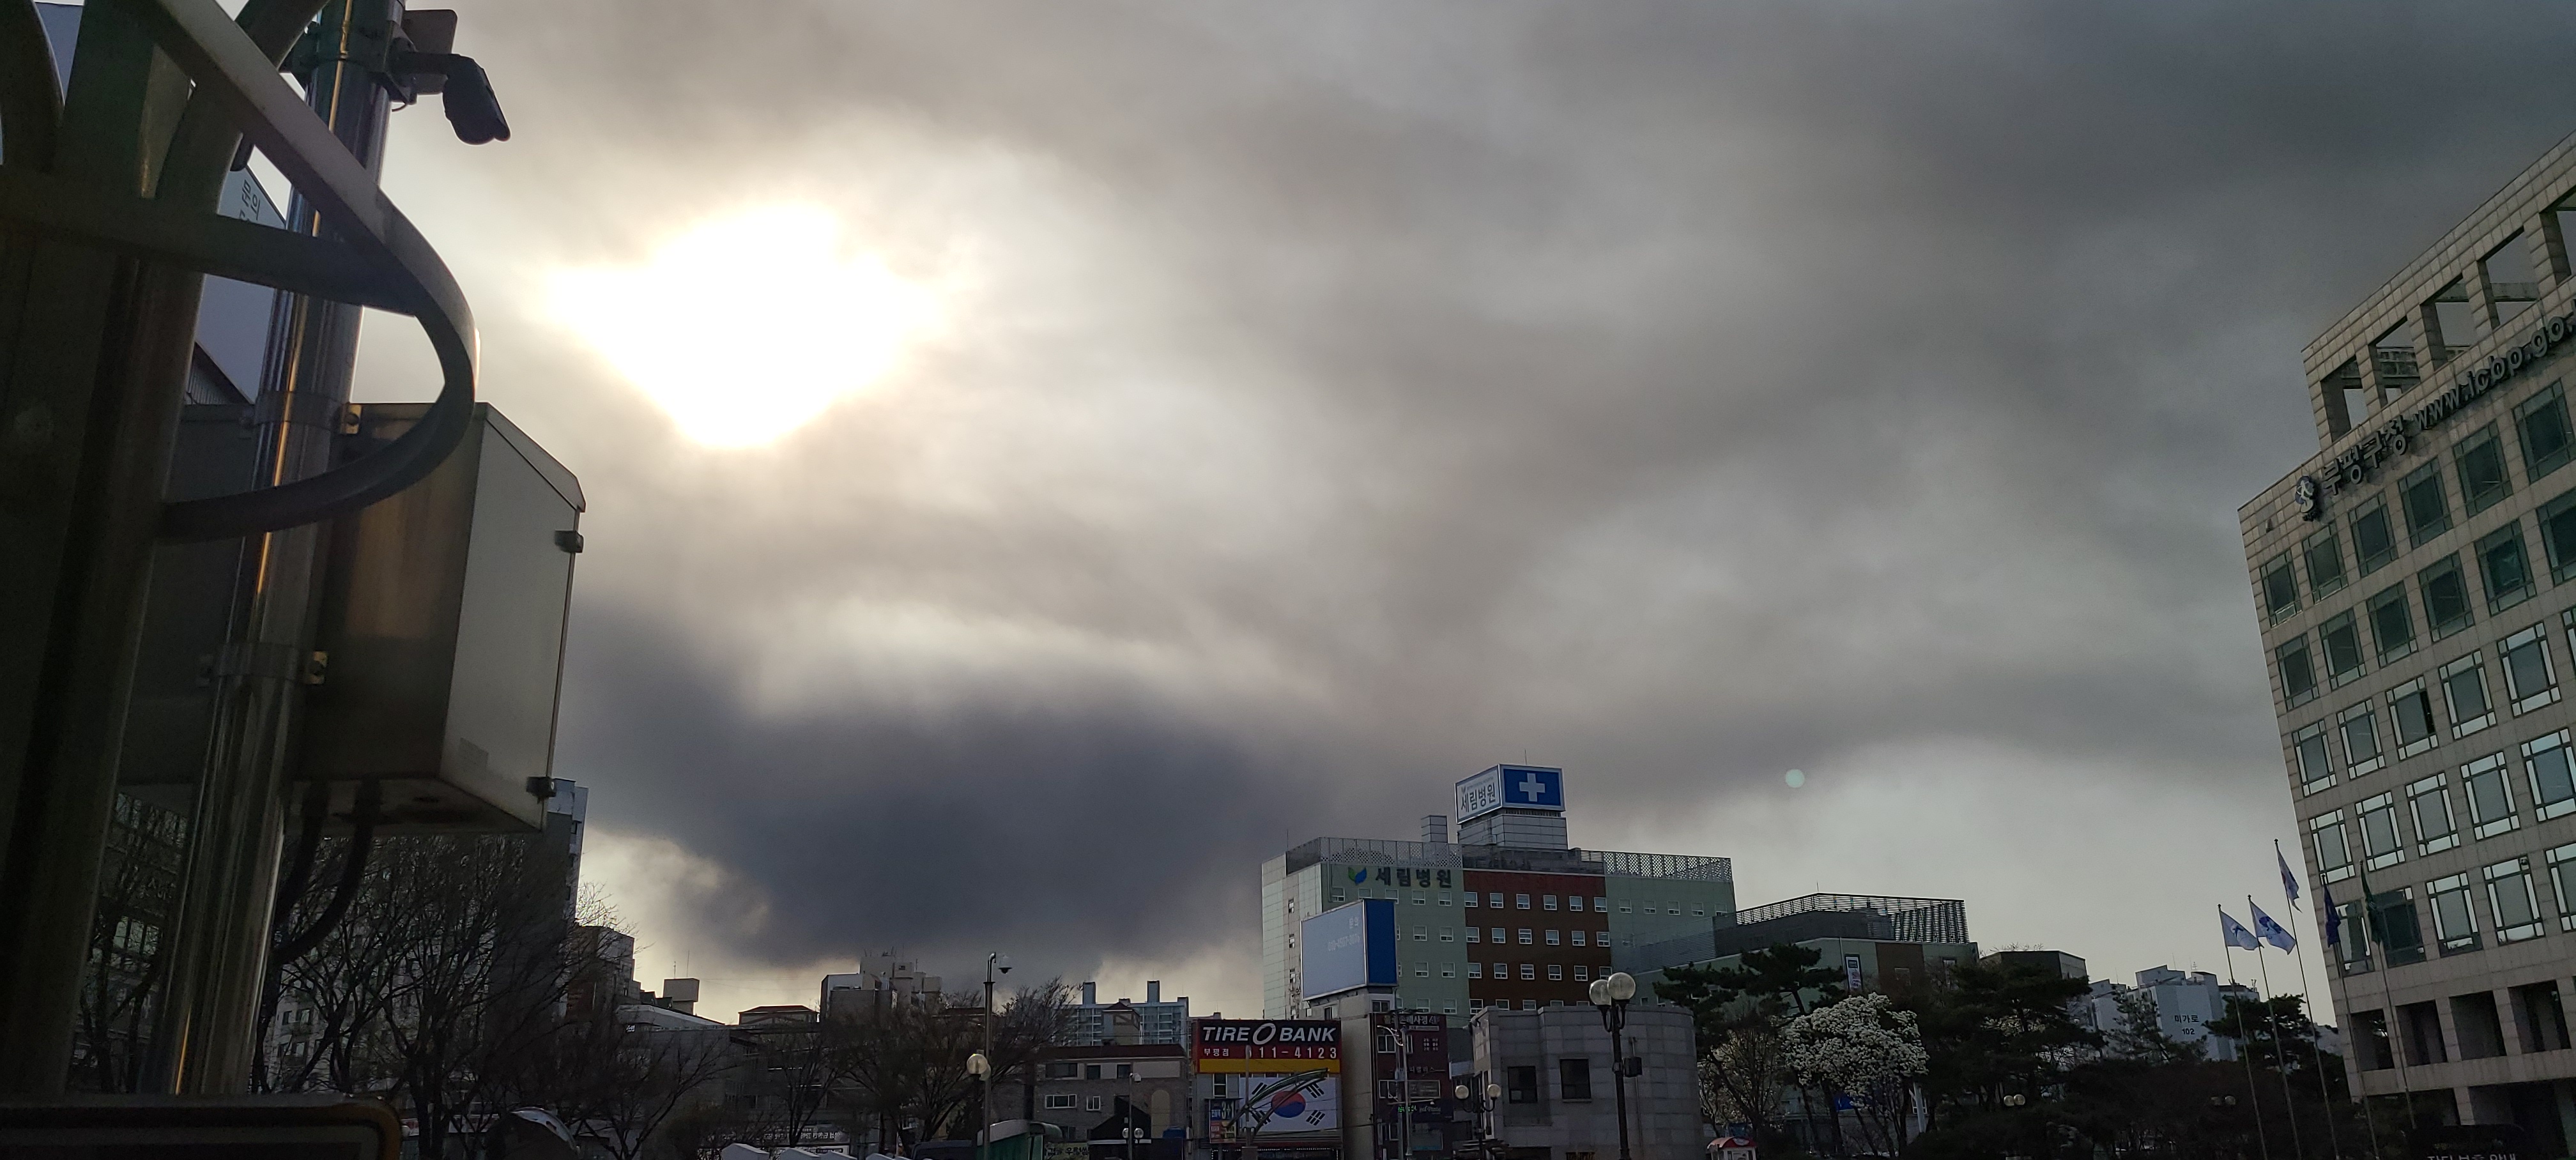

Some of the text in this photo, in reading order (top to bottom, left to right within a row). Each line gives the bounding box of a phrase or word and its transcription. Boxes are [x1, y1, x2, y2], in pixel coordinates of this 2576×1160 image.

[2322, 299, 2576, 496] 부평구청 www.icbp.go.
[1460, 782, 1496, 813] 세림병원
[1376, 867, 1452, 888] 세림병원
[2174, 1014, 2199, 1023] 미가로
[1279, 1027, 1337, 1042] BANK
[1204, 1048, 1229, 1057] 부평점
